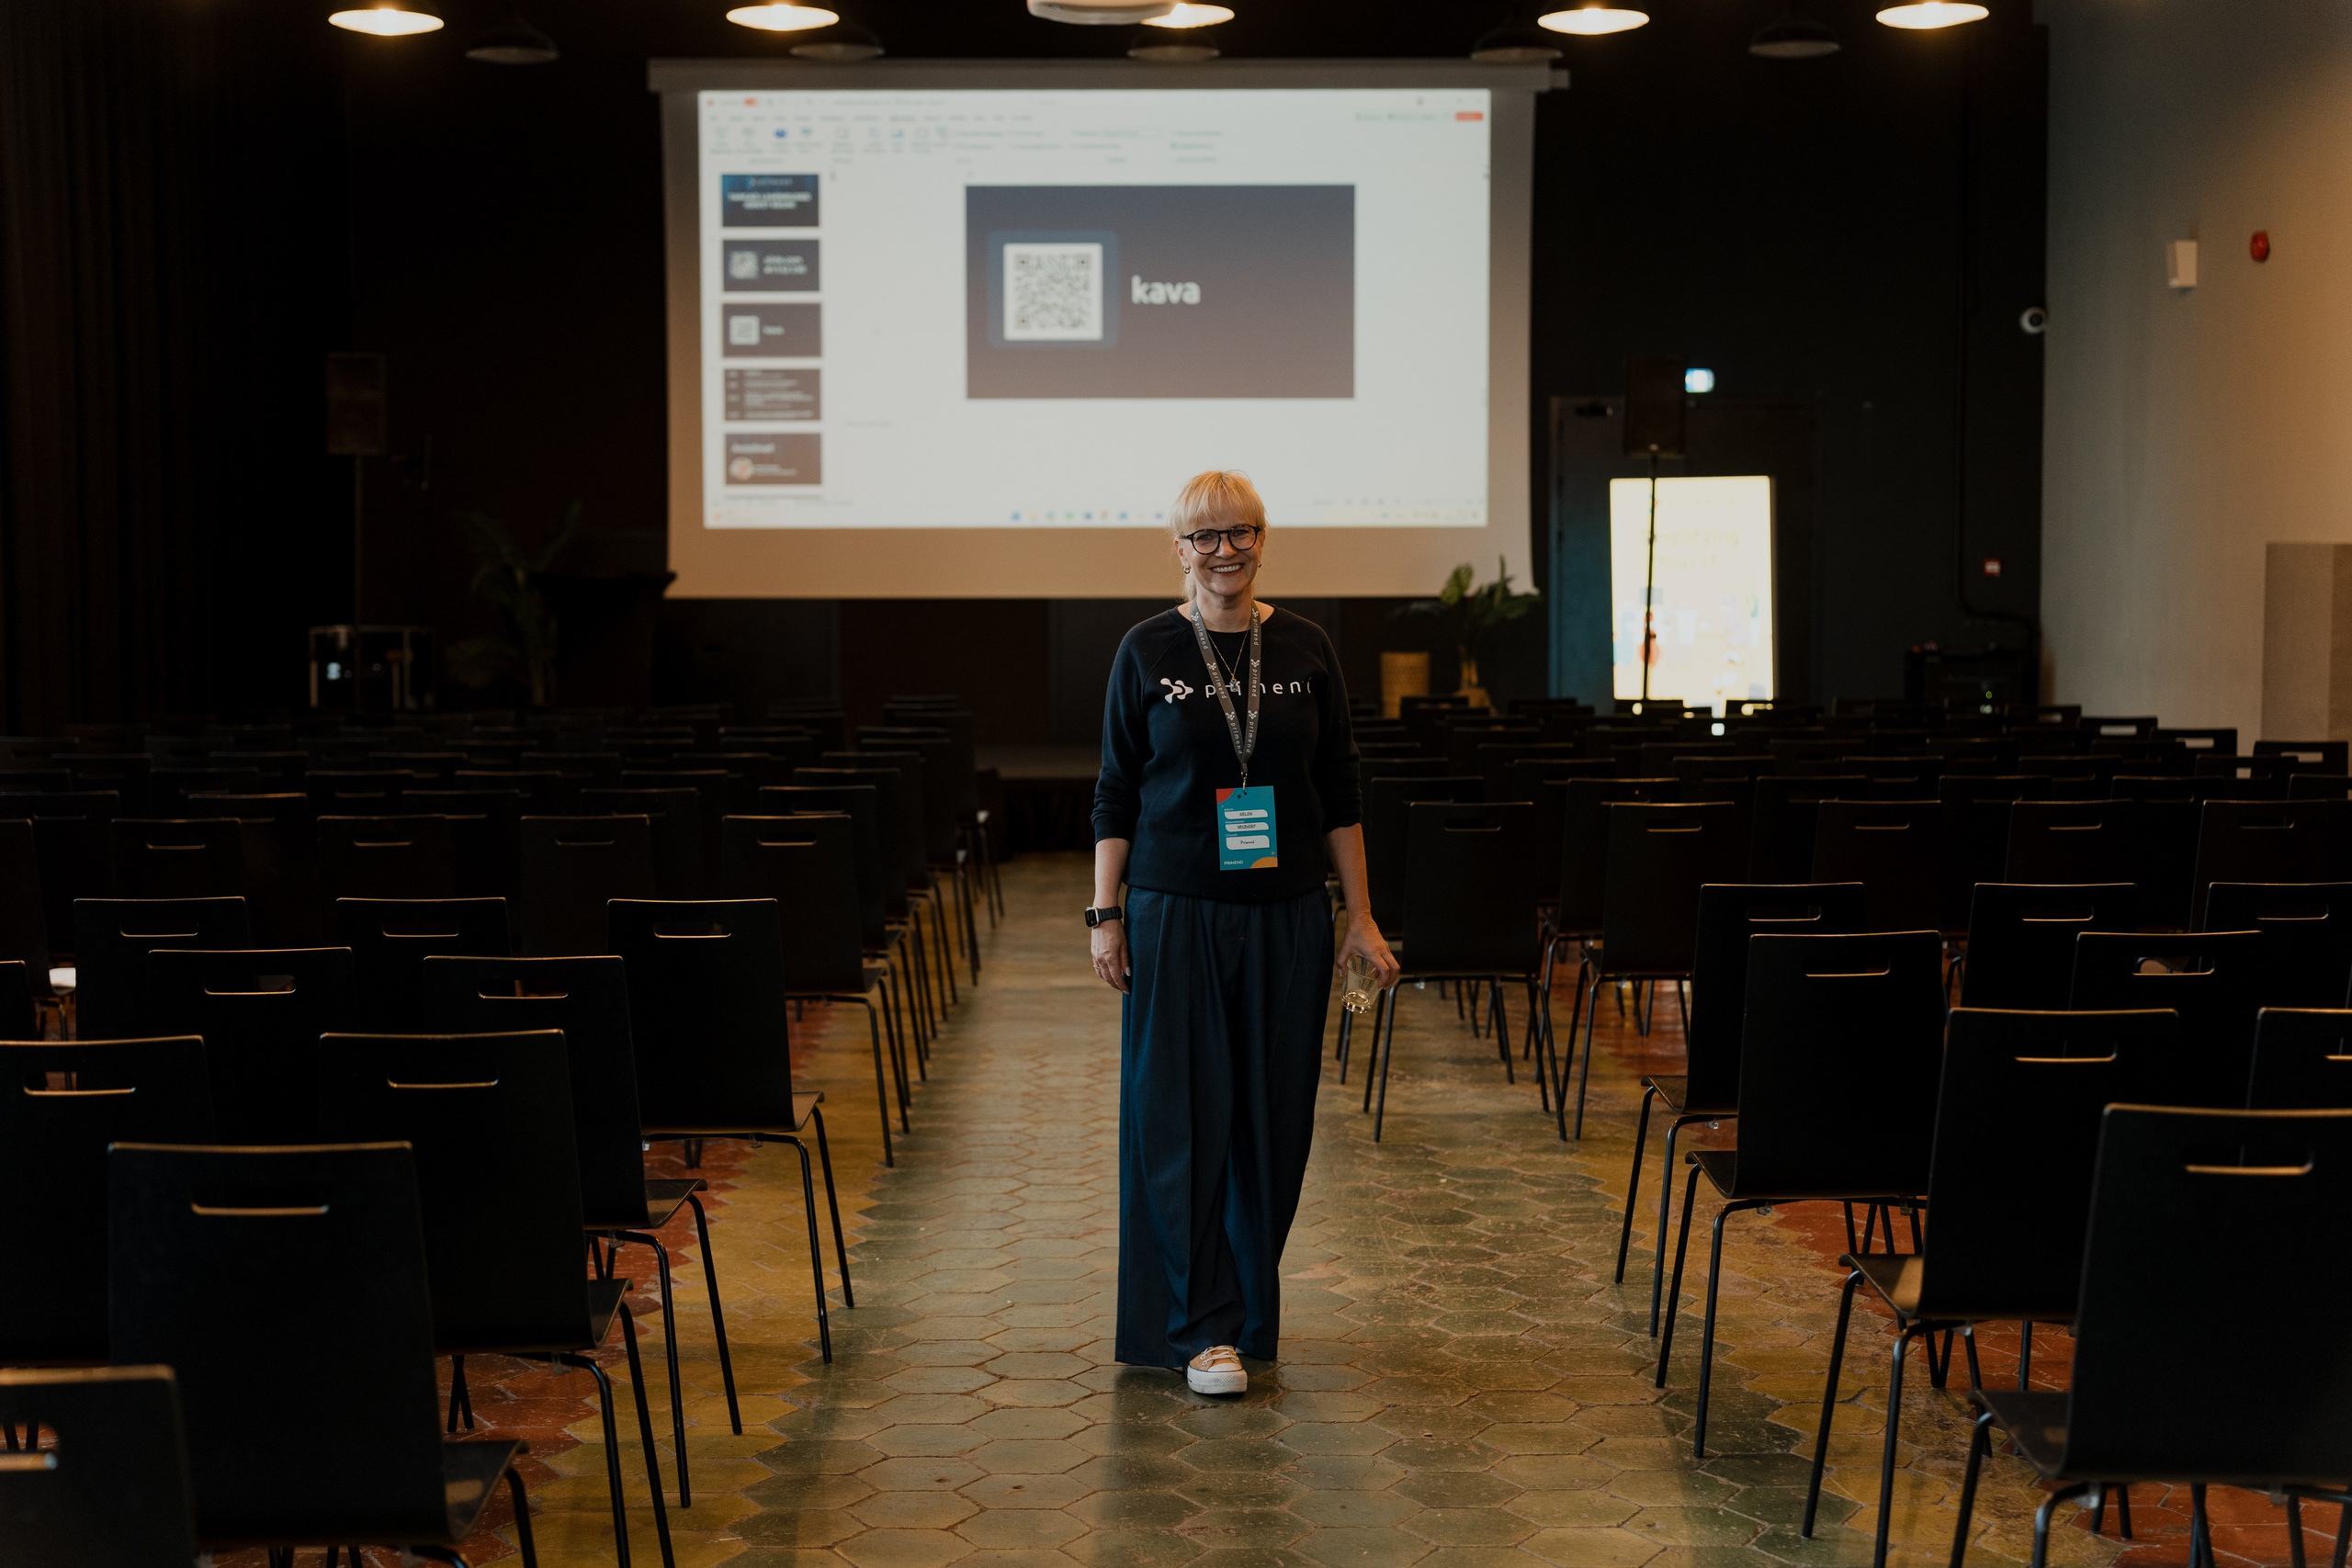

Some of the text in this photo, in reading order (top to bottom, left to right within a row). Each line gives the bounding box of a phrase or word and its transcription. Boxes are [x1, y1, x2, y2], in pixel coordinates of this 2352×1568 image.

[1131, 275, 1201, 305] kava
[1195, 622, 1208, 649] primend
[1213, 671, 1227, 699] primend
[1231, 722, 1242, 754] primend
[1246, 721, 1254, 753] primend
